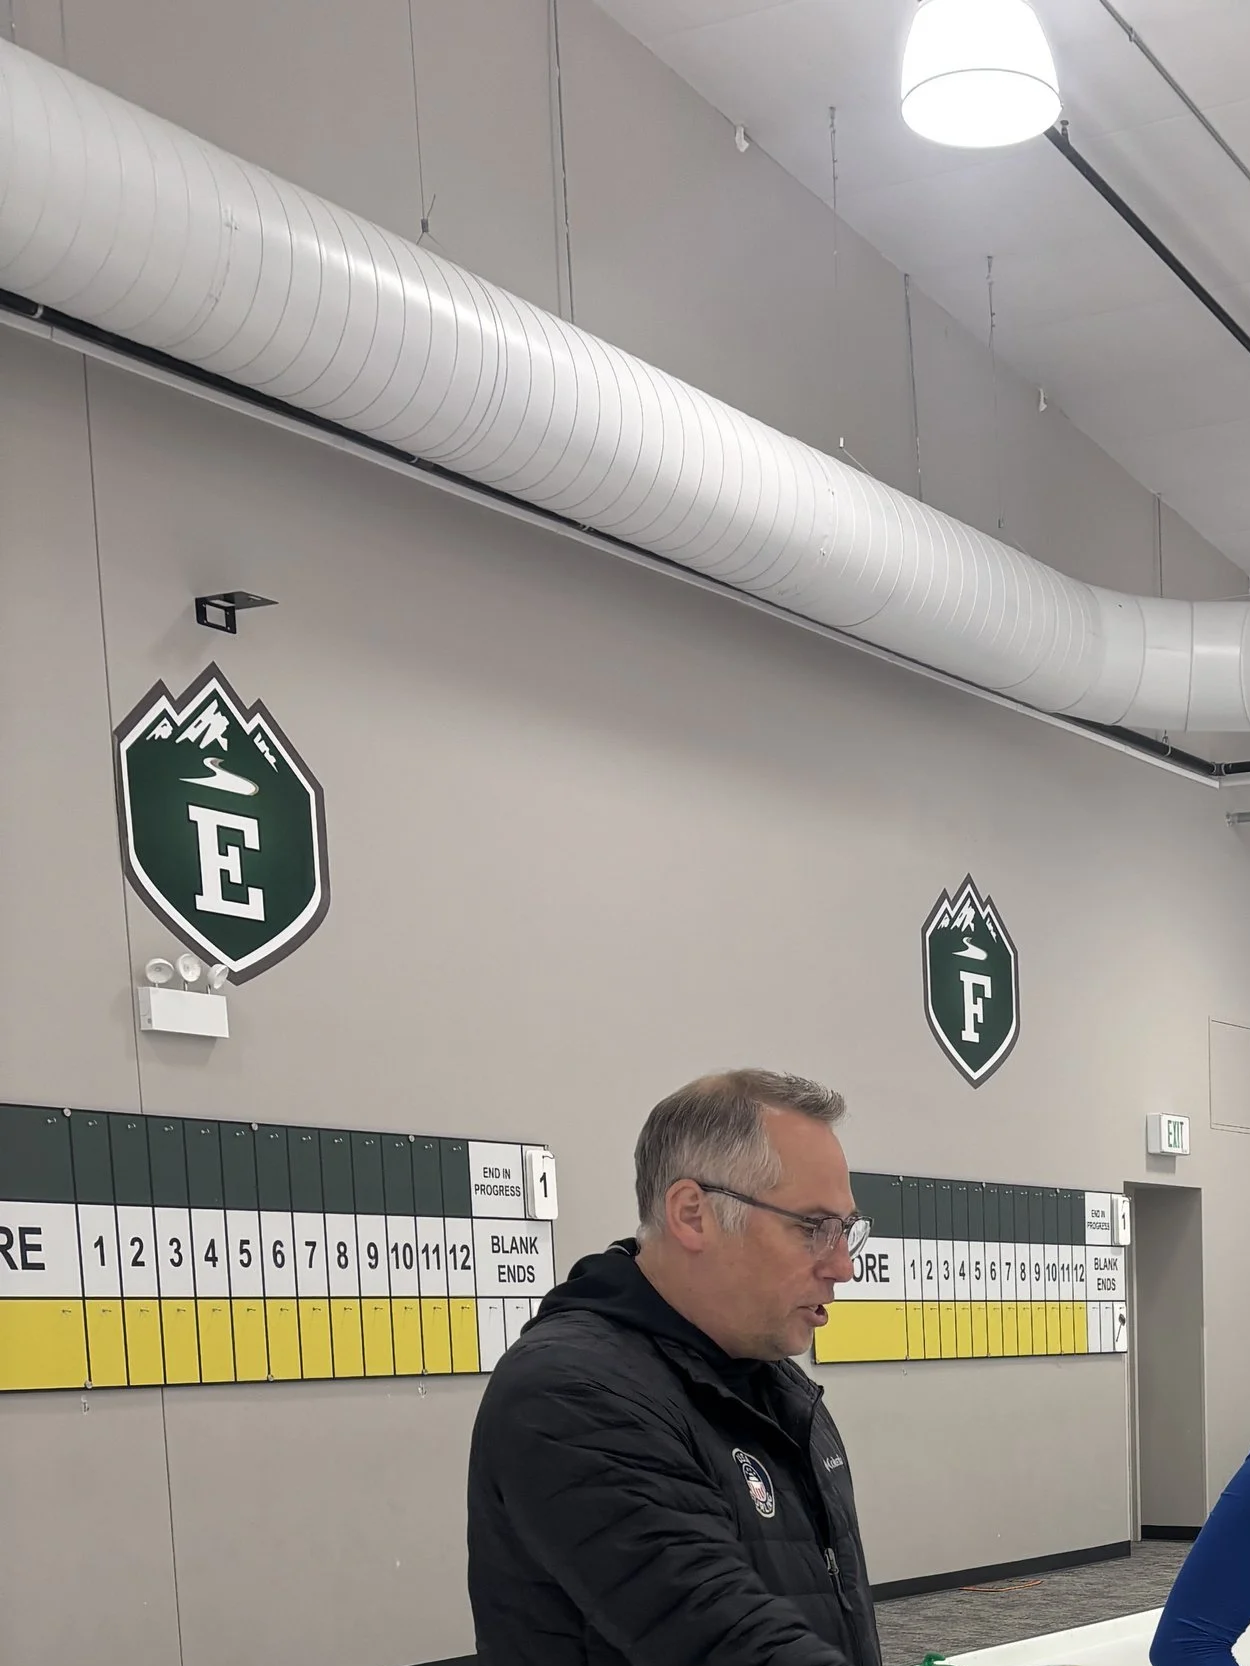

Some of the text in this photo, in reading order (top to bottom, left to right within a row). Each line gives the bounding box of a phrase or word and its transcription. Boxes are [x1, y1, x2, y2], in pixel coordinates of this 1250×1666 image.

[188, 804, 266, 922] E
[959, 970, 992, 1044] F
[1167, 1119, 1184, 1149] EXIT
[482, 1167, 511, 1180] END IN
[474, 1183, 522, 1197] PROGRESS
[539, 1172, 548, 1198] 1
[1121, 1212, 1126, 1231] 1
[94, 1235, 106, 1267] 1
[129, 1236, 146, 1267] 2
[168, 1237, 183, 1268] 3
[204, 1238, 219, 1268] 4
[239, 1239, 252, 1268] 5
[272, 1239, 286, 1269] 6
[304, 1240, 317, 1269] 7
[336, 1241, 349, 1270] 8
[366, 1241, 379, 1270] 9
[390, 1242, 414, 1270] 10
[421, 1243, 441, 1271] 11
[449, 1243, 472, 1271] 12
[490, 1235, 539, 1254] BLANK
[497, 1264, 536, 1283] ENDS
[851, 1253, 1085, 1283] ORE 1 2 3 4 5 6 7 8 9 10 11 12
[1093, 1257, 1119, 1271] BLANK
[1096, 1277, 1116, 1291] ENDS
